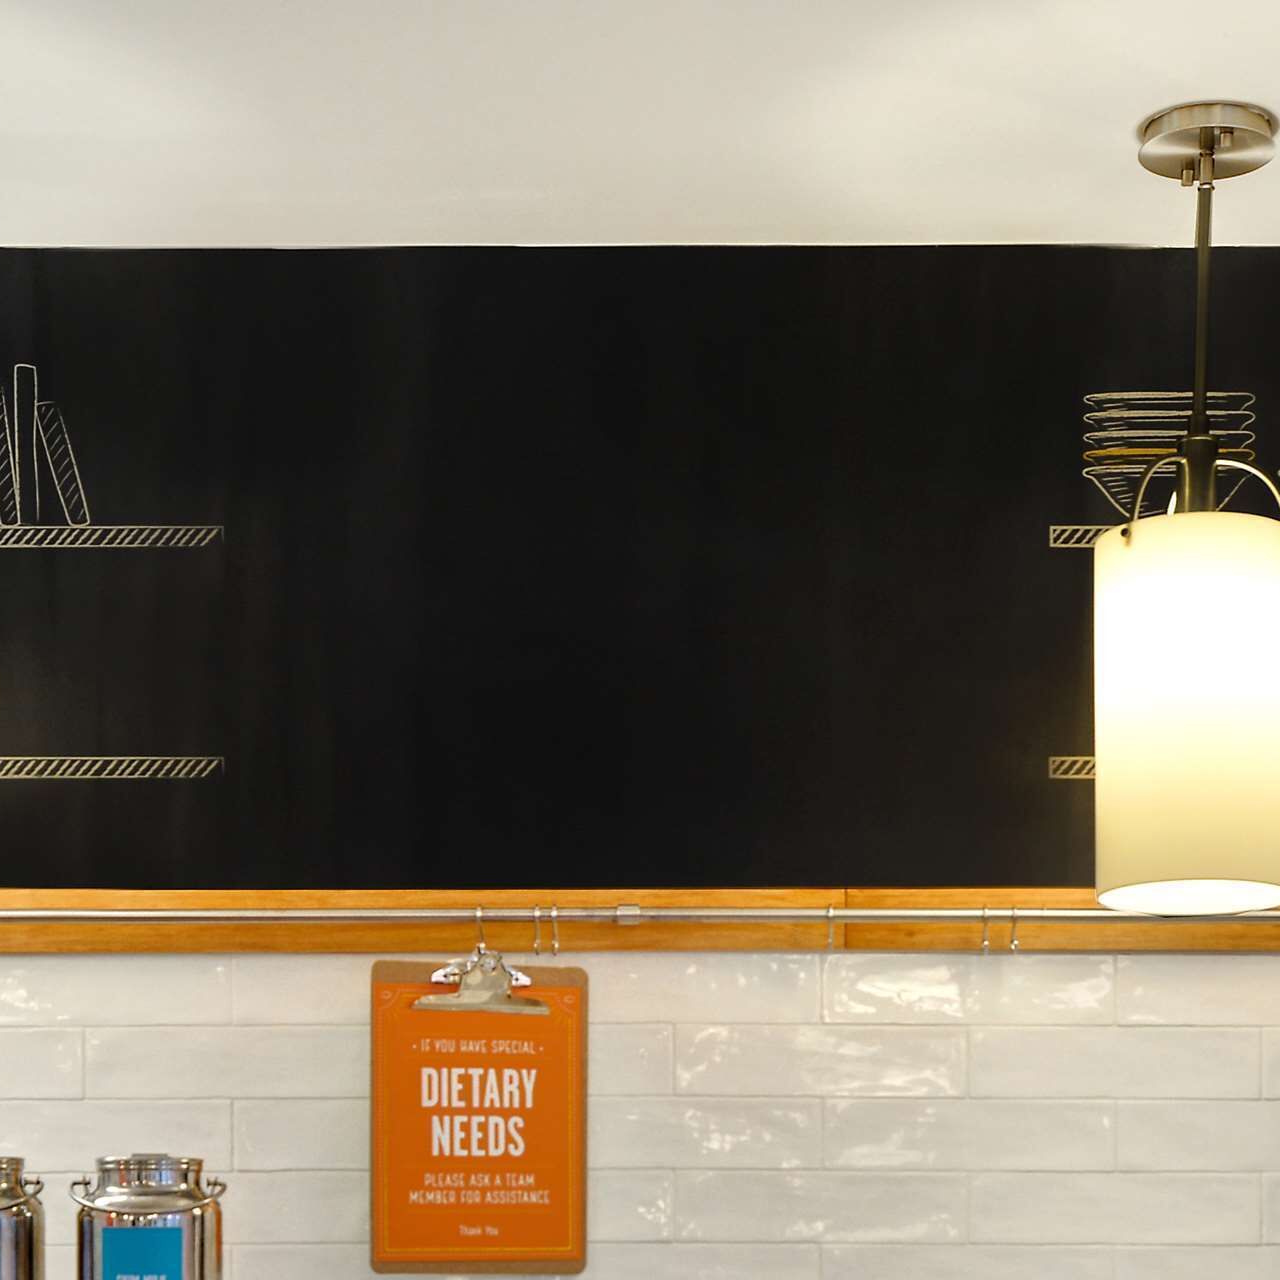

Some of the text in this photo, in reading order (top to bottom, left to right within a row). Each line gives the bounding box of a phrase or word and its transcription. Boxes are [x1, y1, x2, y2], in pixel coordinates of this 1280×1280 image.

[421, 1039, 536, 1054] IF YOU HAVE SPECIAL
[421, 1067, 537, 1109] DIETARY
[431, 1115, 525, 1157] NEEDS
[424, 1173, 535, 1187] PLEASE ASK A TEAM
[409, 1190, 550, 1204] MEMBER FOR ASSISTANCE
